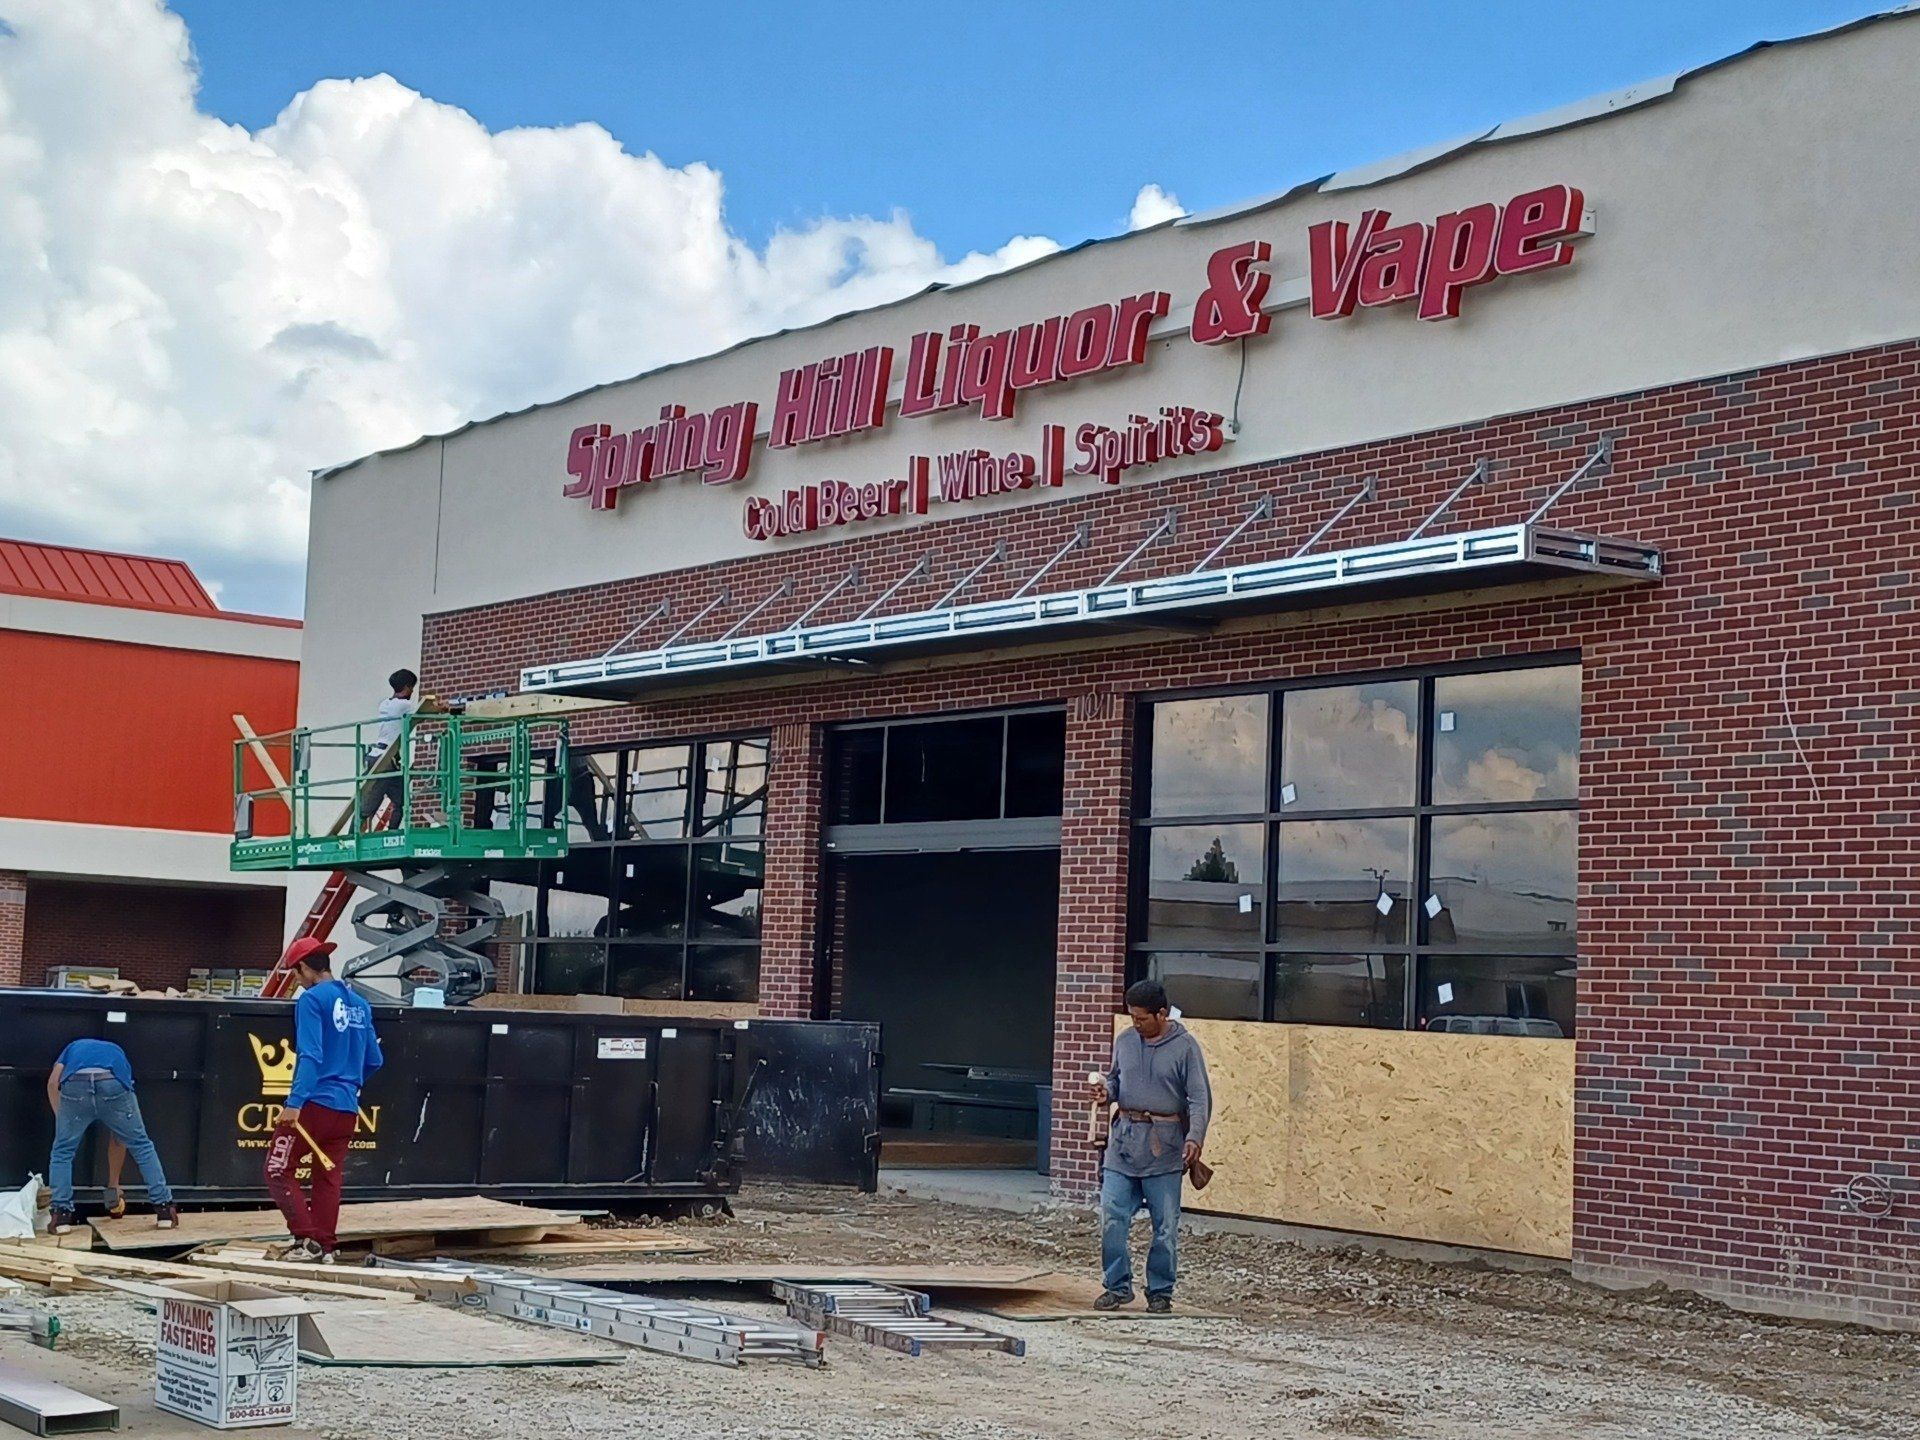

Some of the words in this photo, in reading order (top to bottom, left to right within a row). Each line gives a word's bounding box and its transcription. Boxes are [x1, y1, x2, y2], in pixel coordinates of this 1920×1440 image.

[563, 401, 759, 511] Spring
[767, 345, 894, 451] Hill
[899, 291, 1171, 421] Liquor
[1190, 240, 1272, 346] &
[1308, 184, 1584, 322] Vape
[743, 485, 819, 541] Cold
[817, 479, 908, 527] Beer
[937, 448, 1035, 503] Wine
[1072, 406, 1225, 485] Spirits
[160, 1321, 217, 1358] FASTENER
[163, 1299, 214, 1333] DYNAMIC
